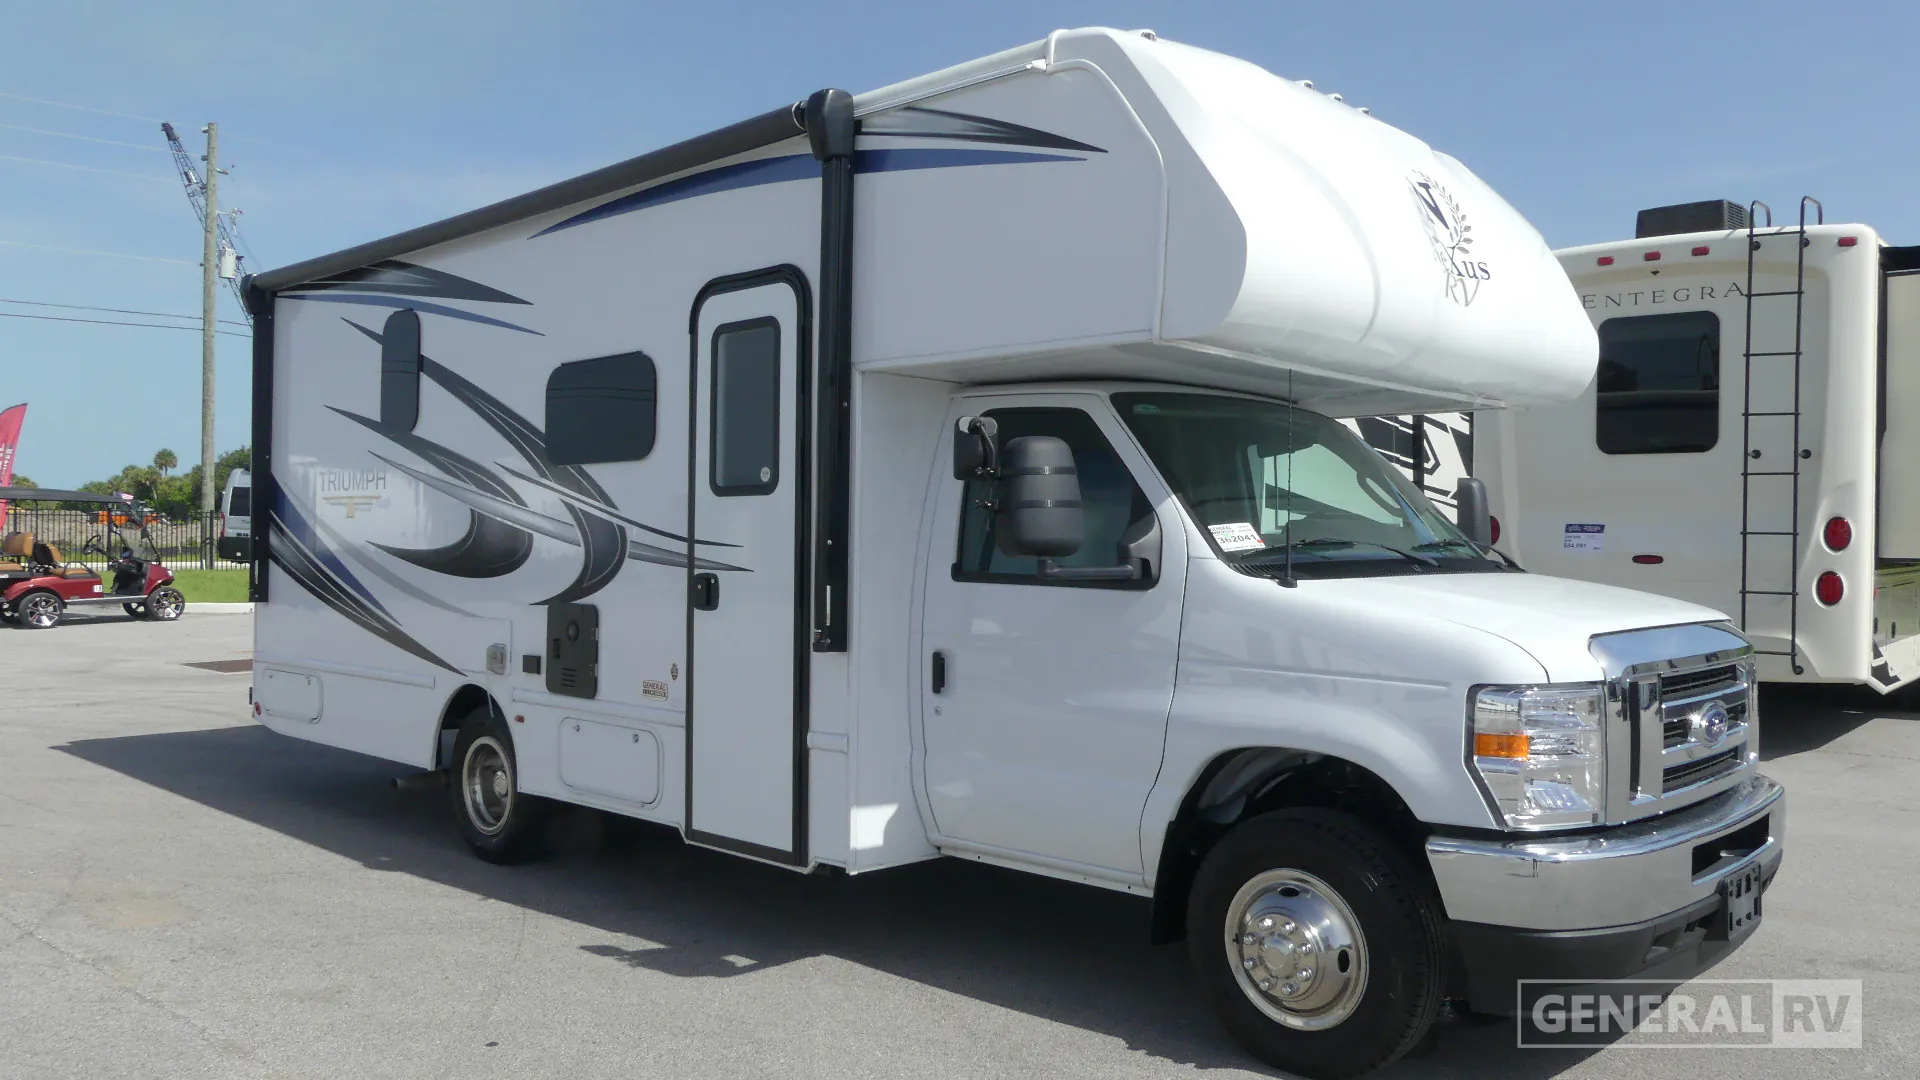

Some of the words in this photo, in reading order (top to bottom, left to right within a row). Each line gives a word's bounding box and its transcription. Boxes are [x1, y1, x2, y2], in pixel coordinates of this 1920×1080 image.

[1582, 282, 1745, 310] ENTEGRA
[319, 470, 387, 492] TRIUMPH
[1217, 534, 1257, 544] 362041
